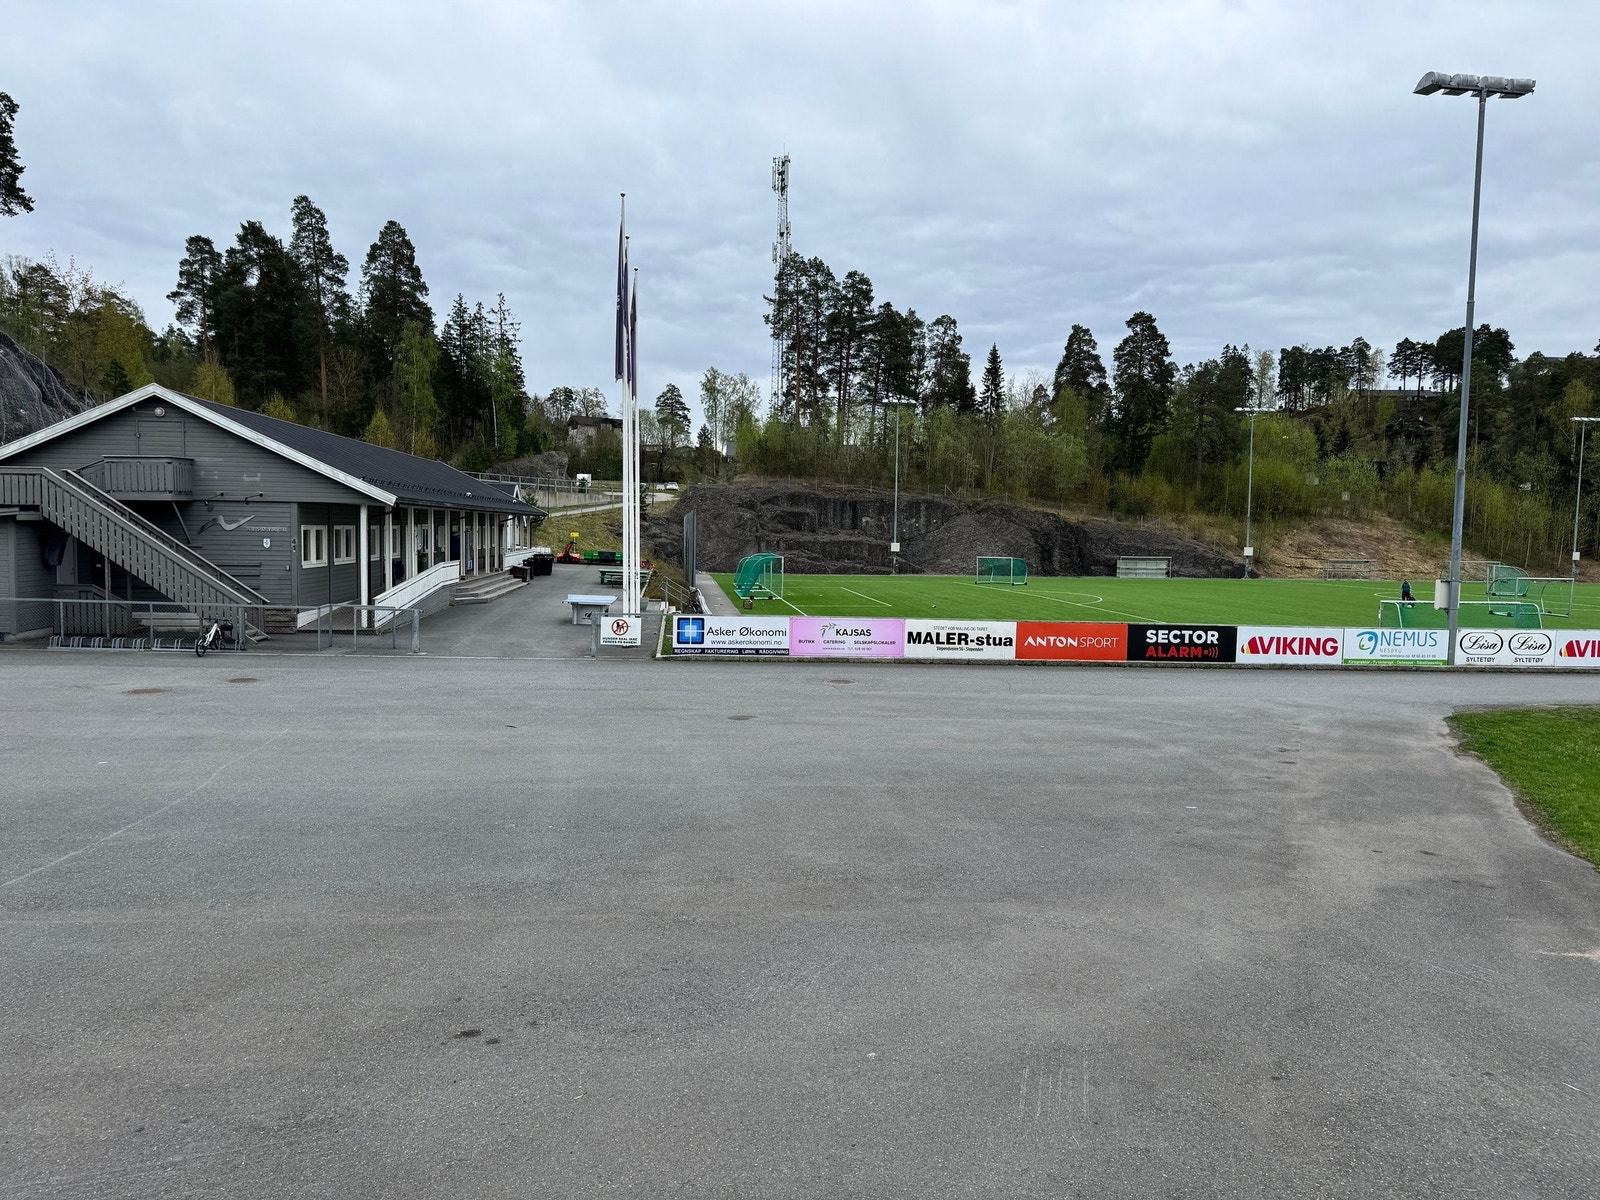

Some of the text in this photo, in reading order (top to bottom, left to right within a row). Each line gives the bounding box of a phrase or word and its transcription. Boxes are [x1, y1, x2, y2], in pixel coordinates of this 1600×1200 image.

[706, 626, 787, 637] Asker Økonomi
[835, 628, 872, 637] KAJSAS
[1145, 630, 1219, 644] SECTOR
[907, 631, 1013, 647] MALER-stua
[1024, 635, 1119, 648] ANTON SPORT
[1380, 631, 1438, 647] NEMUS
[1464, 635, 1547, 651] Lisa Lisa
[1145, 645, 1202, 658] ALARM
[1258, 636, 1338, 657] VIKING
